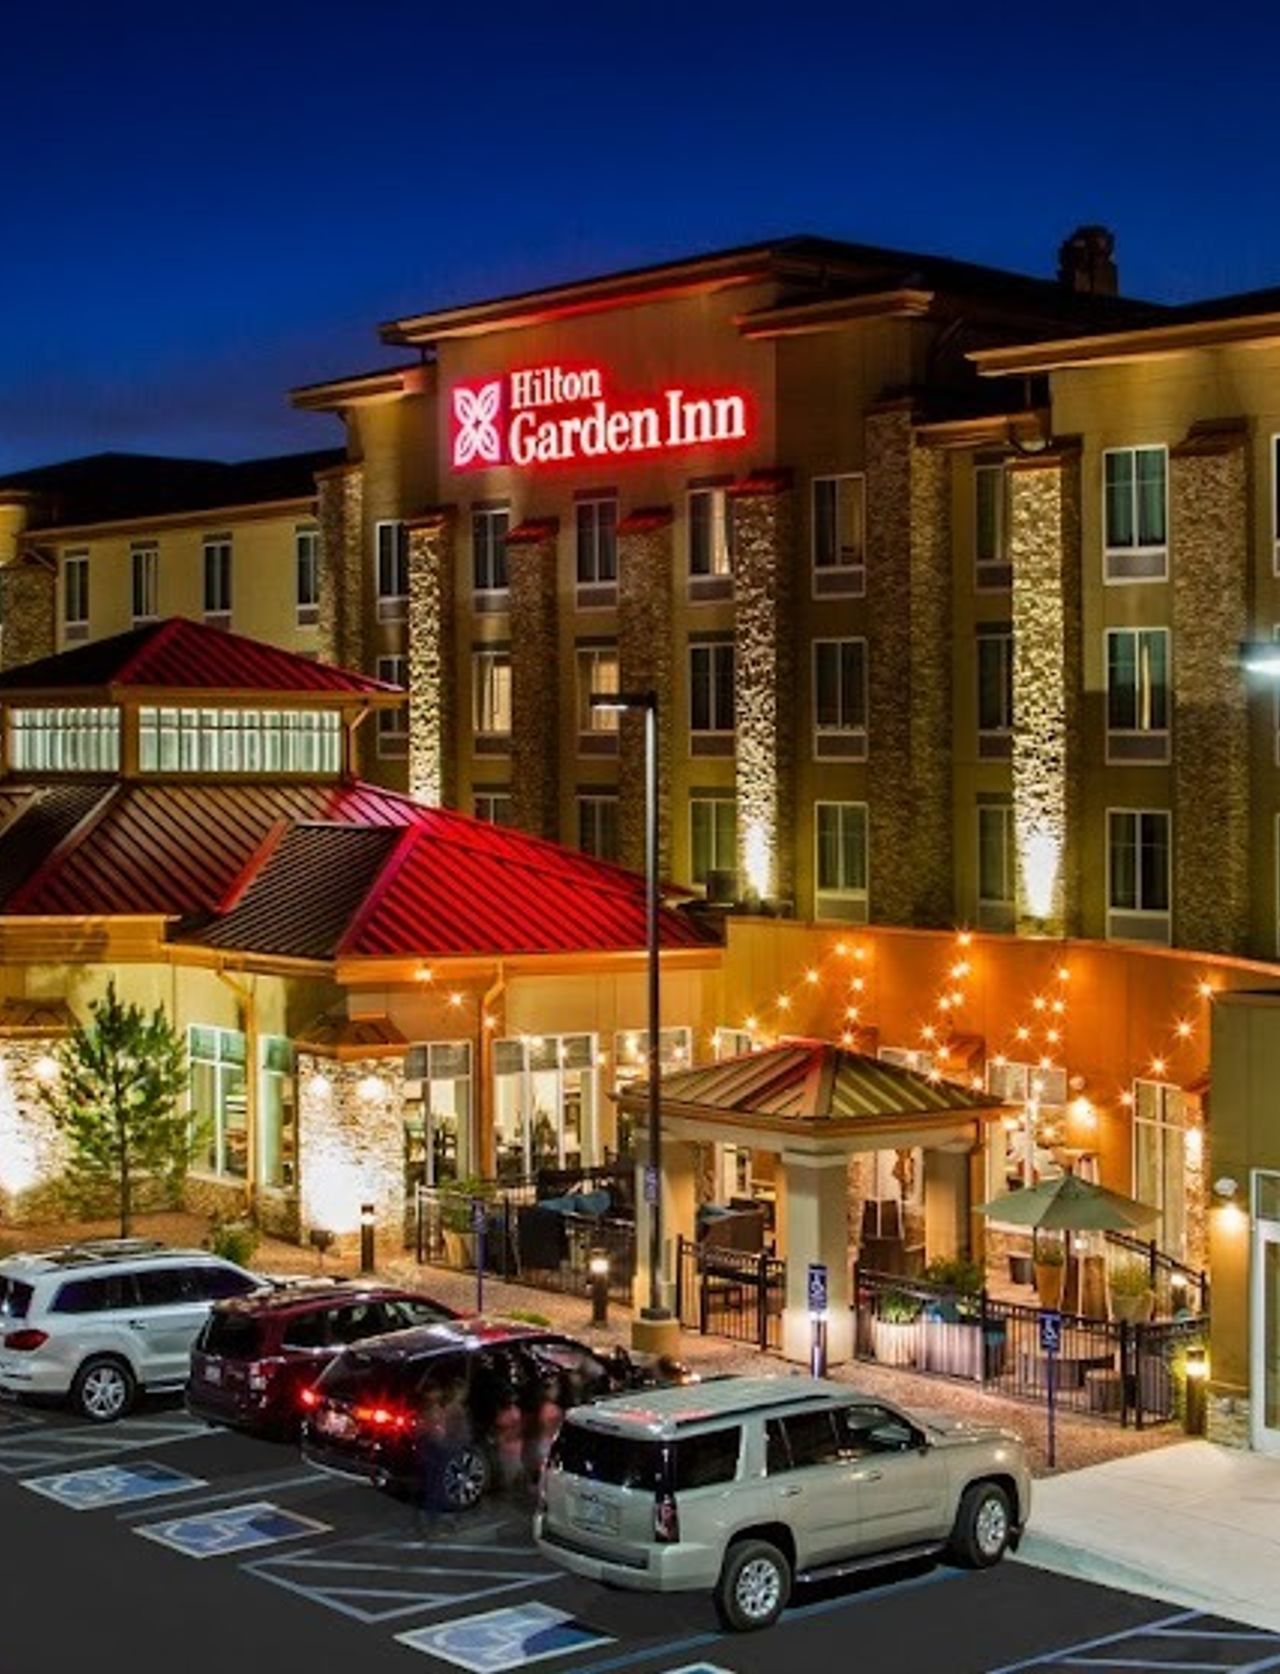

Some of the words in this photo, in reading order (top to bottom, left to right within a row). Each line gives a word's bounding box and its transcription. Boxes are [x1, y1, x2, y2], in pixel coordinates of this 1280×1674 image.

[510, 366, 601, 409] Hilton
[509, 402, 661, 465] Garden
[665, 389, 746, 447] Inn
